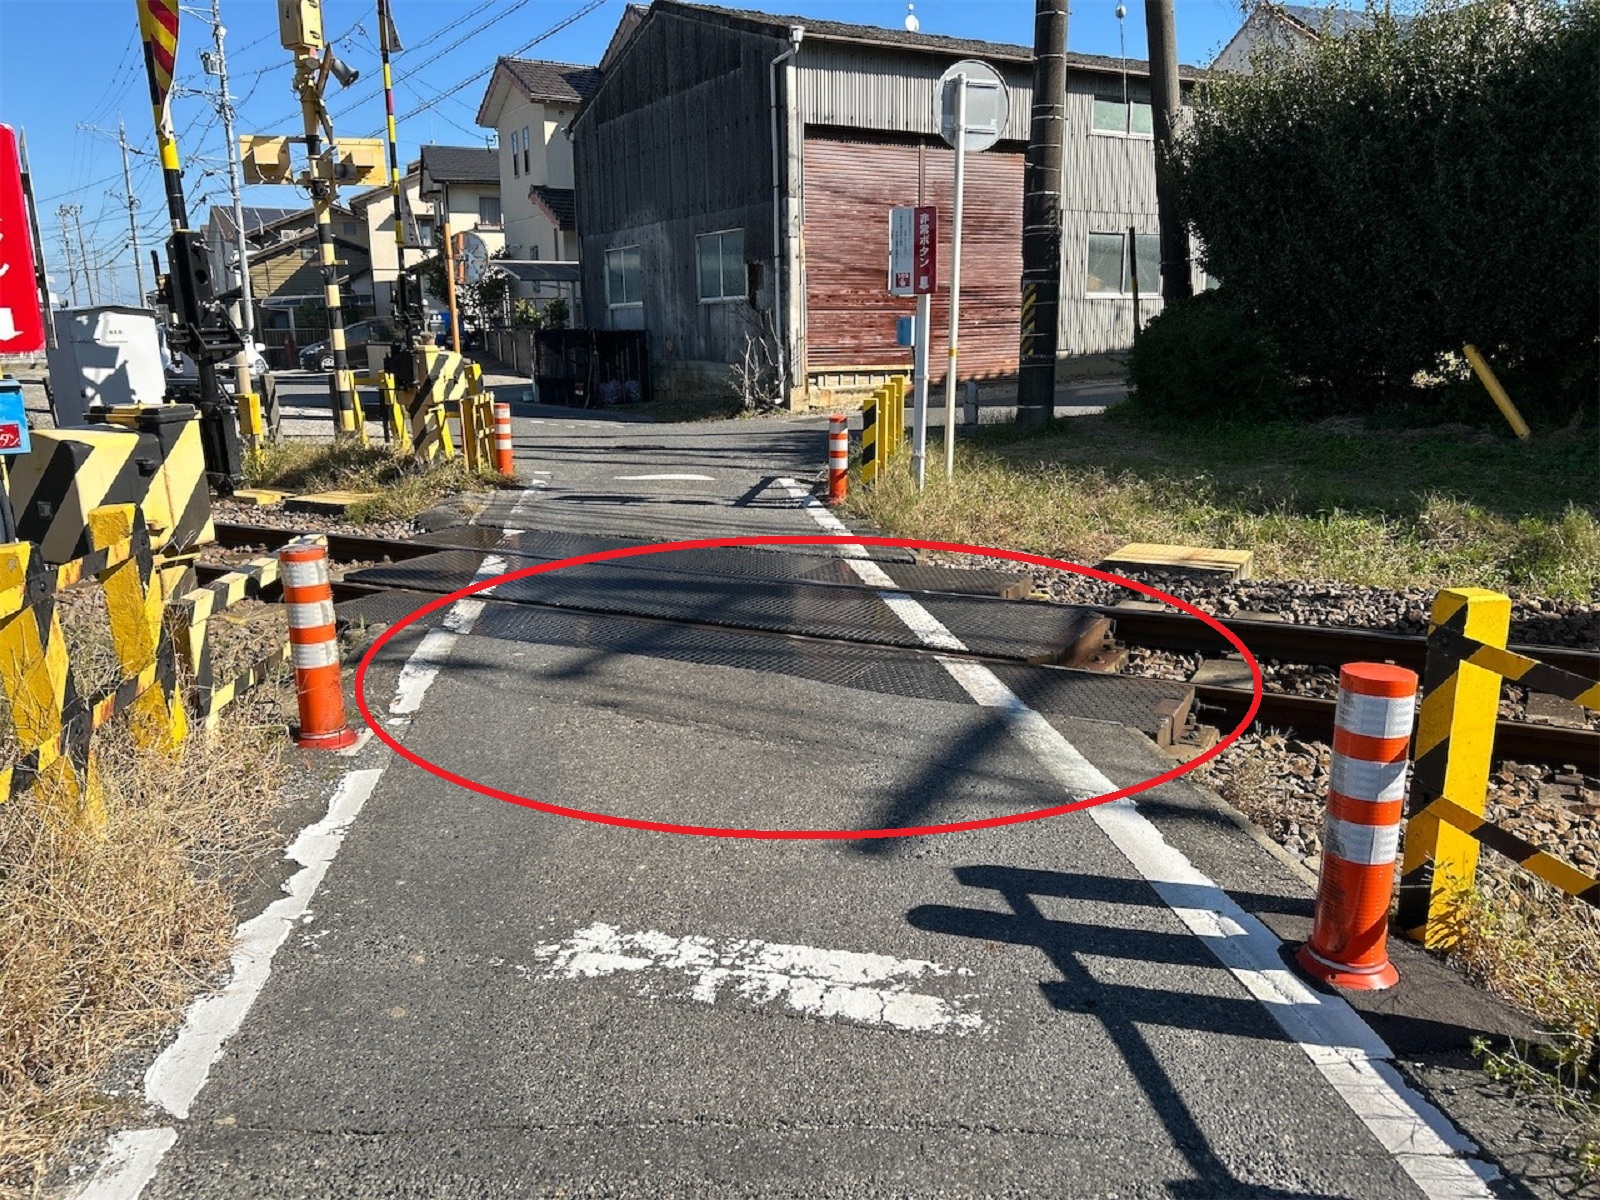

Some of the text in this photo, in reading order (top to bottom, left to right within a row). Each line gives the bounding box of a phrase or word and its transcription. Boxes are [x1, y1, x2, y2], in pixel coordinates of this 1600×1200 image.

[919, 212, 930, 267] 非常ボタン
